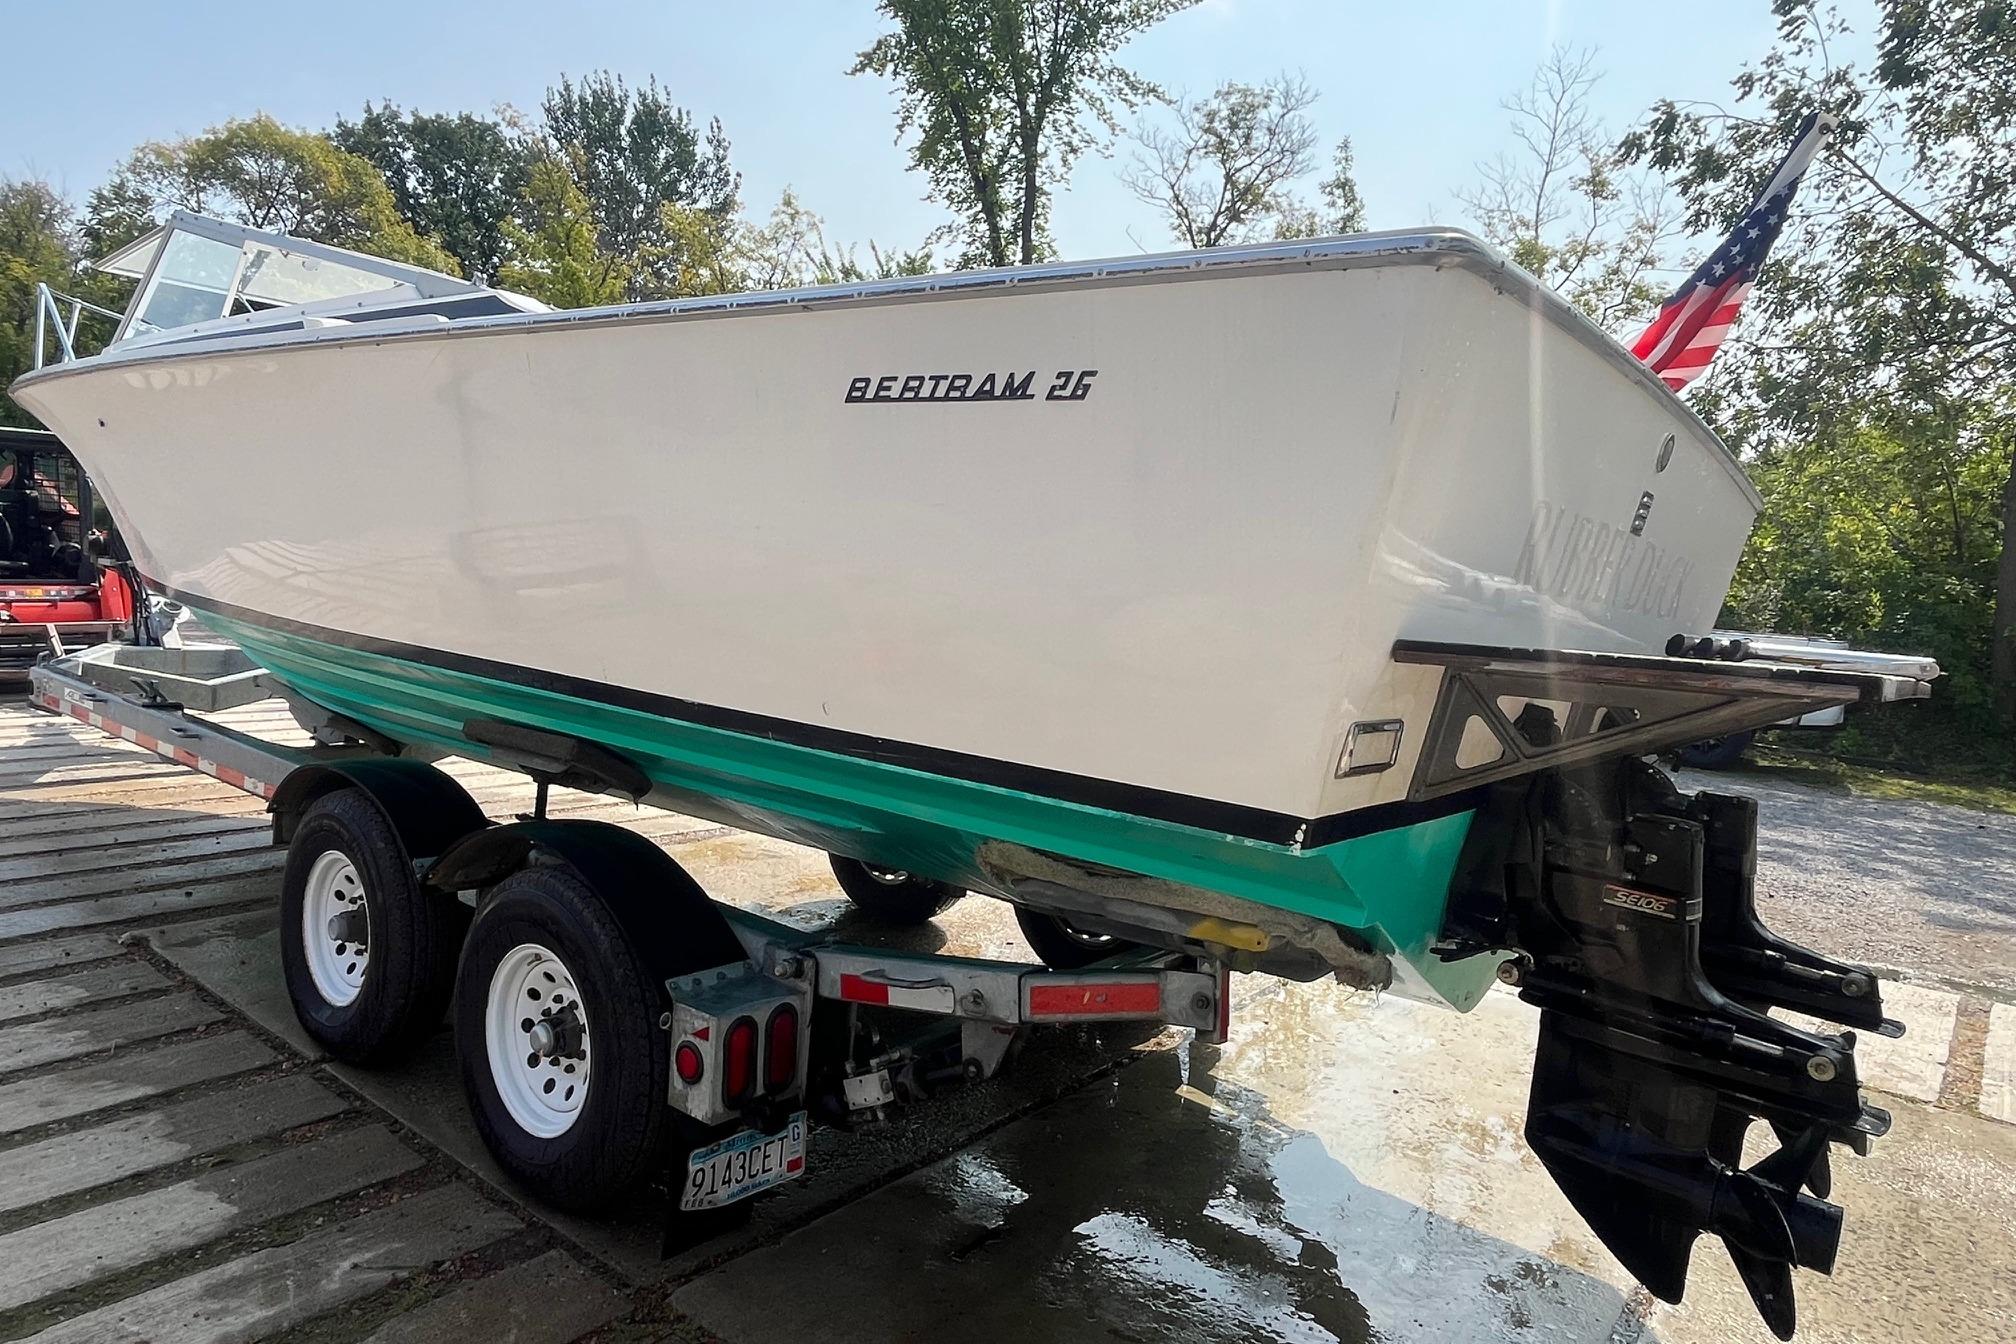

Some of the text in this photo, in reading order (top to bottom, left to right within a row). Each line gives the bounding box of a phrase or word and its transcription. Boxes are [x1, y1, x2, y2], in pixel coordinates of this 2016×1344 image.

[845, 370, 1098, 403] BERTRAM 26
[1512, 501, 1696, 619] RUBBER DUCK
[691, 1134, 789, 1199] 9143CET
